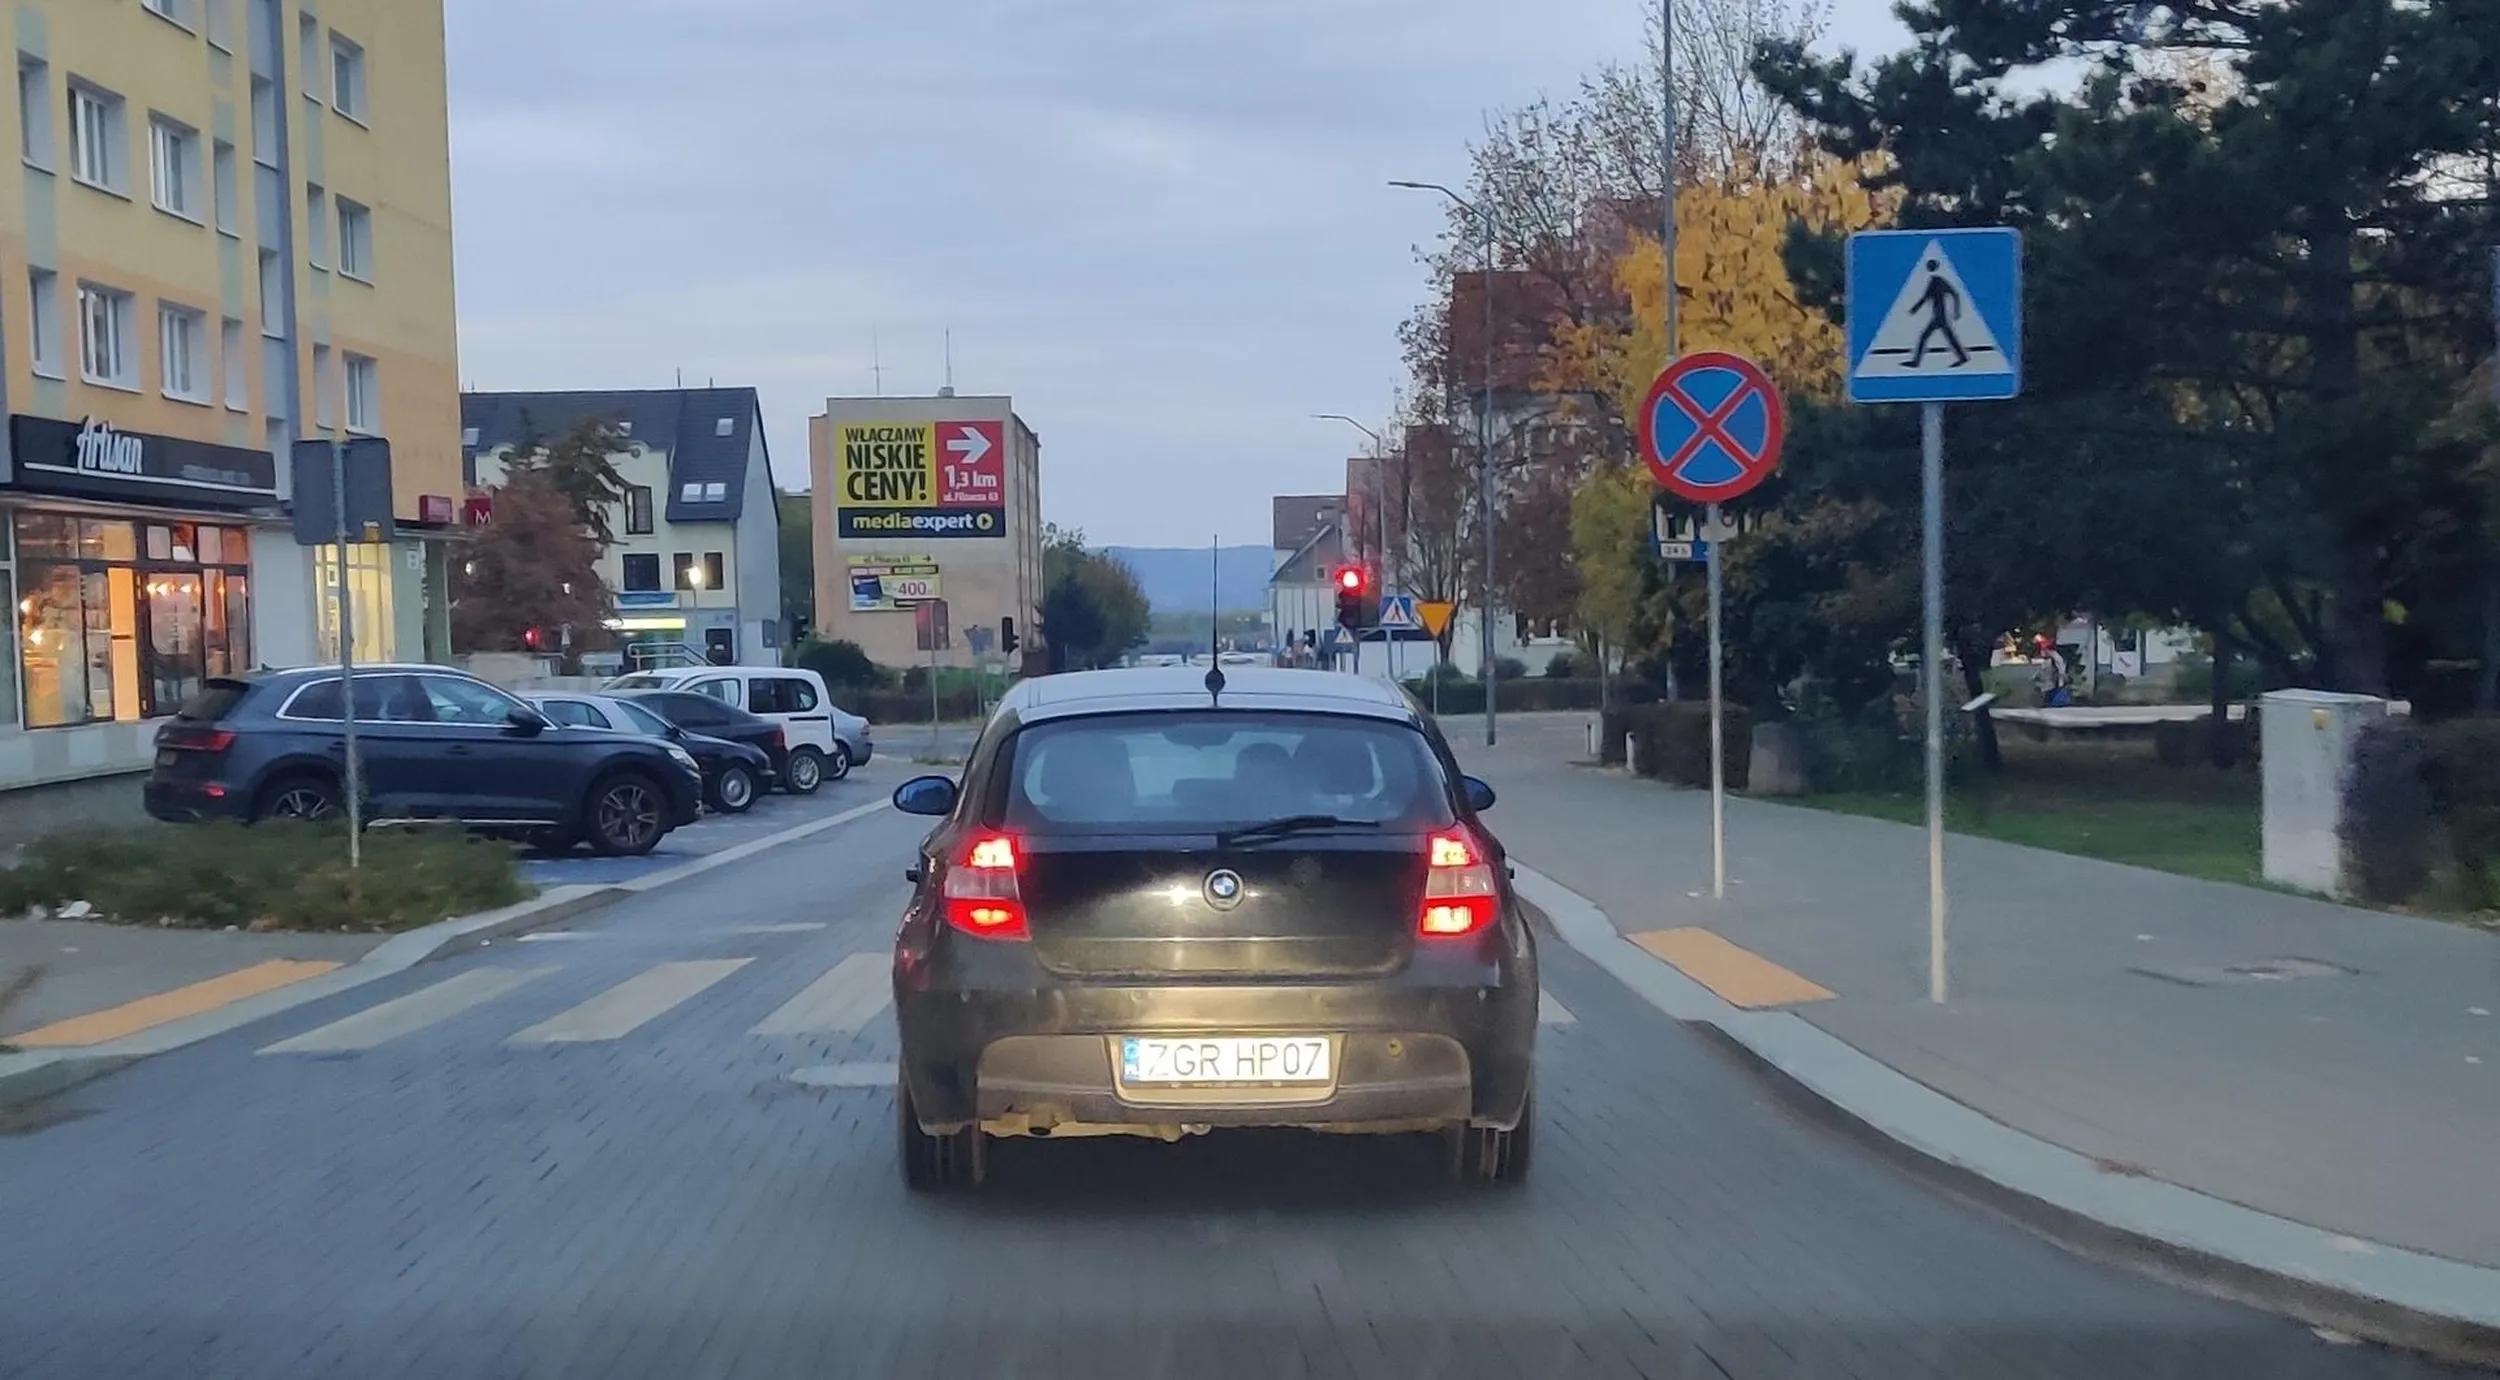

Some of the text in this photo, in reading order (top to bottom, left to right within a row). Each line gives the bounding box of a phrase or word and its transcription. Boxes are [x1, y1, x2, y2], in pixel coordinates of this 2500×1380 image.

[76, 415, 142, 474] Artisan
[846, 444, 926, 470] NISKIE
[846, 471, 927, 501] CENY!
[944, 465, 997, 490] 1,3 km
[474, 508, 491, 525] M
[853, 512, 973, 532] mediaexpert
[1147, 1042, 1322, 1077] ZGR HP07
